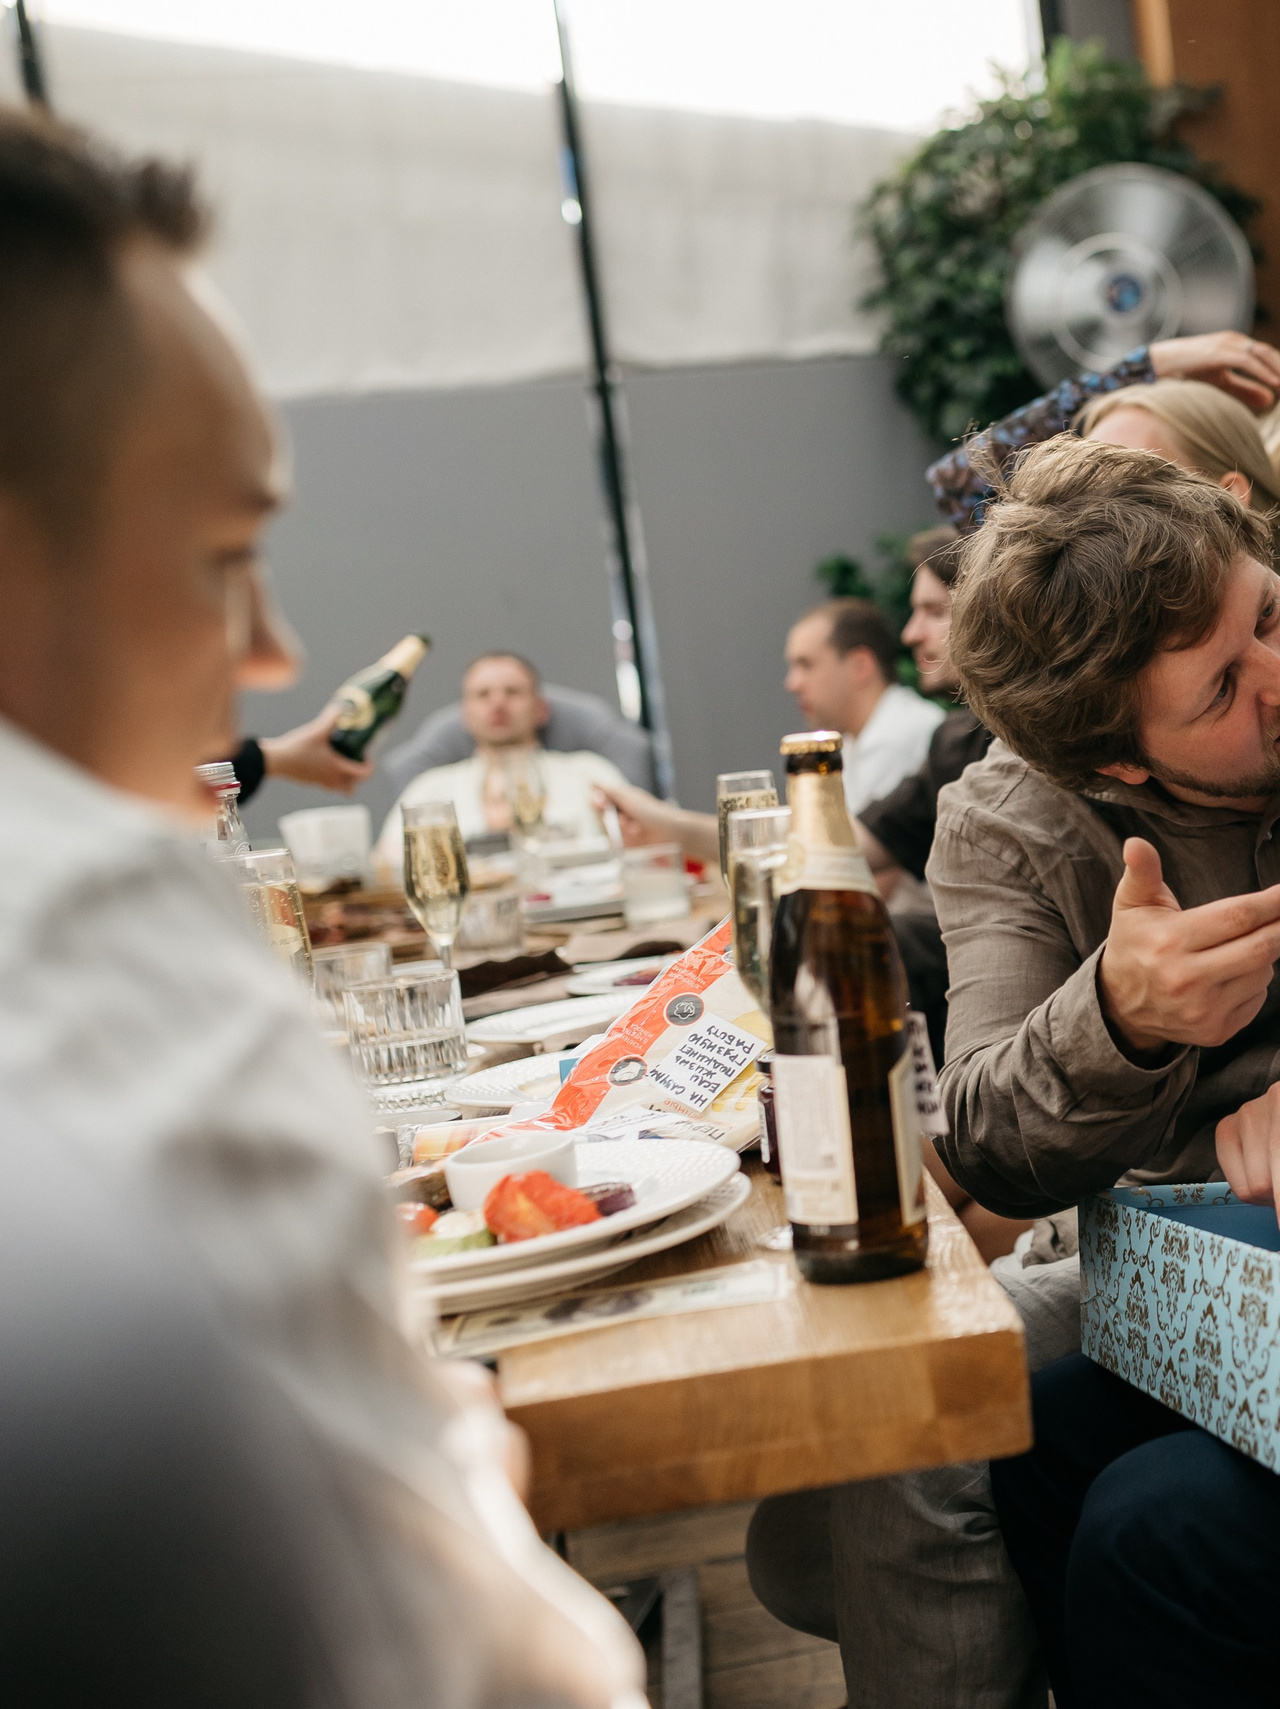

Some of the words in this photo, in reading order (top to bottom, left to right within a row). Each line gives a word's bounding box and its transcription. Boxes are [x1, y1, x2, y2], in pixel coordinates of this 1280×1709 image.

[610, 1029, 643, 1050] УСИЛЕНЕ
[688, 1033, 748, 1067] ГРЯЗНУЮ
[706, 1025, 756, 1055] РАБОТУ
[675, 1055, 717, 1080] ЖИЗНЬ
[678, 1044, 736, 1078] ПОДКИНЕТ
[689, 1074, 721, 1094] ЕСЛИ
[689, 1091, 708, 1108] НА
